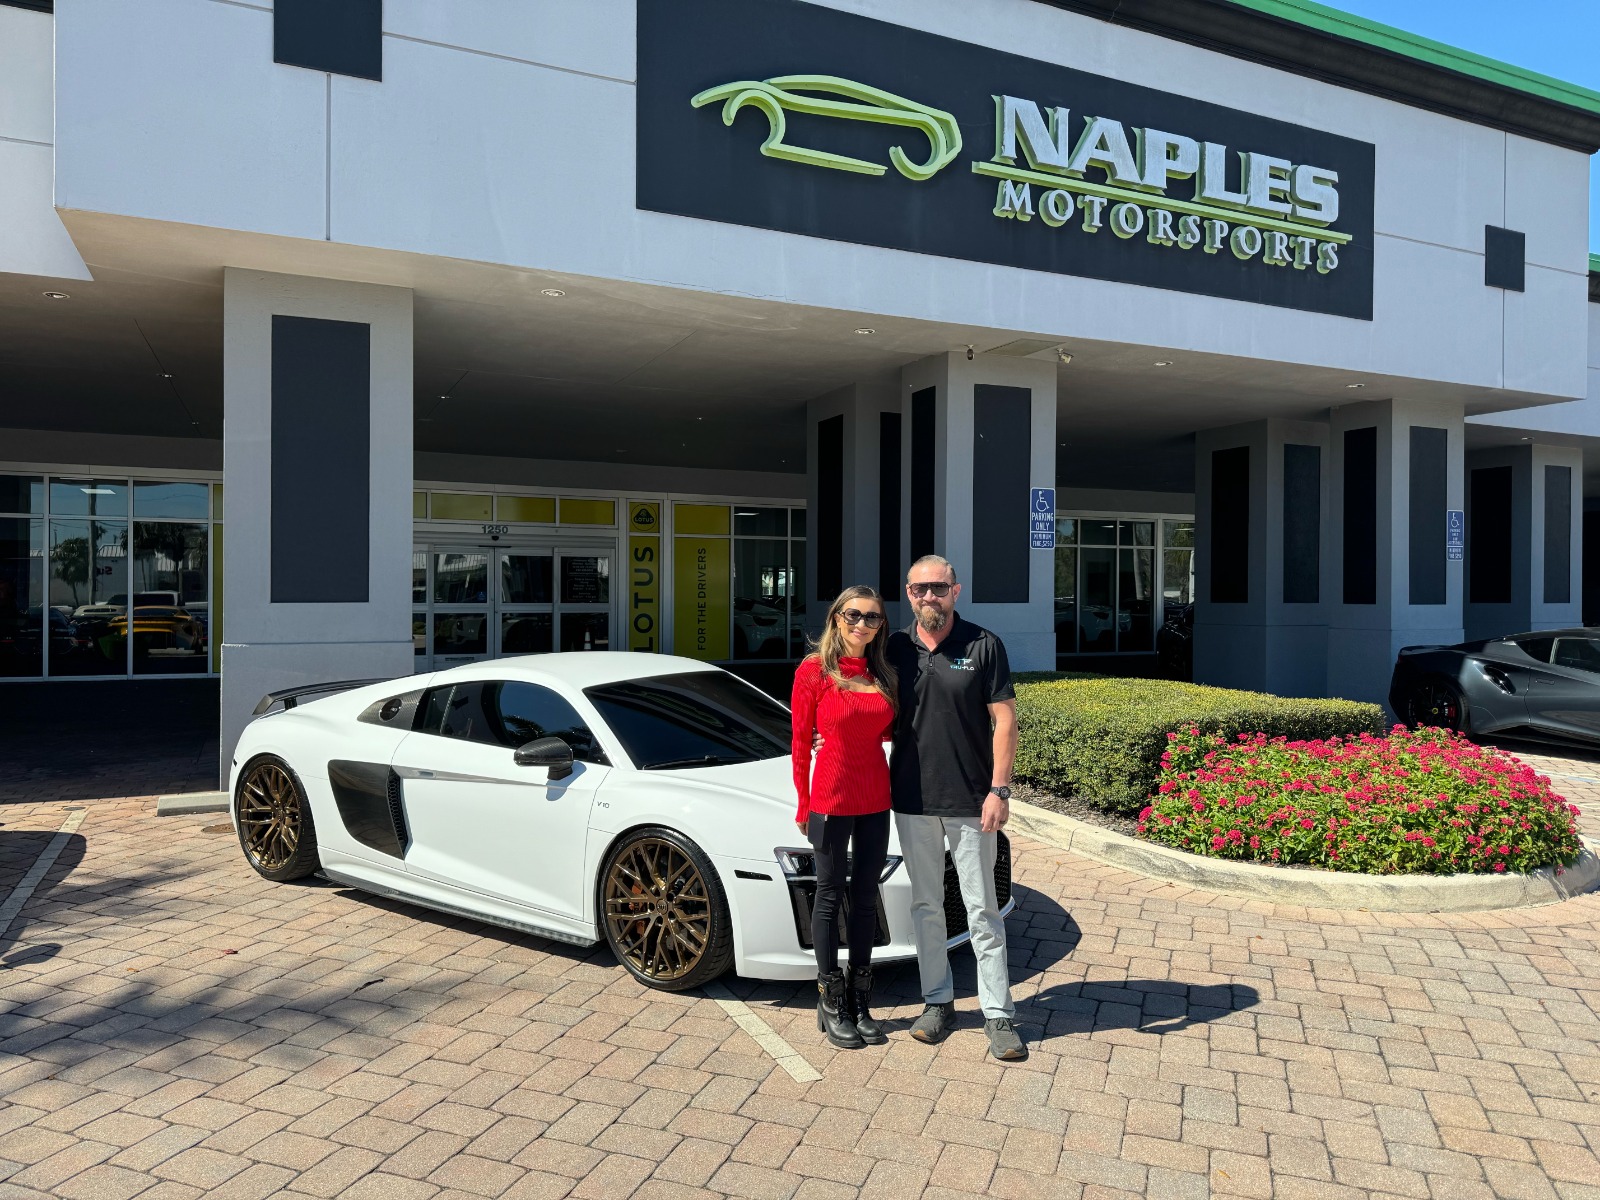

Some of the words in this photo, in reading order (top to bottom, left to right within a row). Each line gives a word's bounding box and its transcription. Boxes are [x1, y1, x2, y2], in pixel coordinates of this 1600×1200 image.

[992, 94, 1339, 225] NAPLES
[994, 179, 1339, 272] MOTORSPORTS
[1031, 512, 1054, 522] PARKING
[1035, 522, 1050, 531] ONLY
[482, 525, 509, 534] 1250
[697, 547, 706, 599] DRIVERS
[633, 546, 654, 653] LOTUS
[697, 602, 706, 624] THE
[697, 628, 706, 651] FOR
